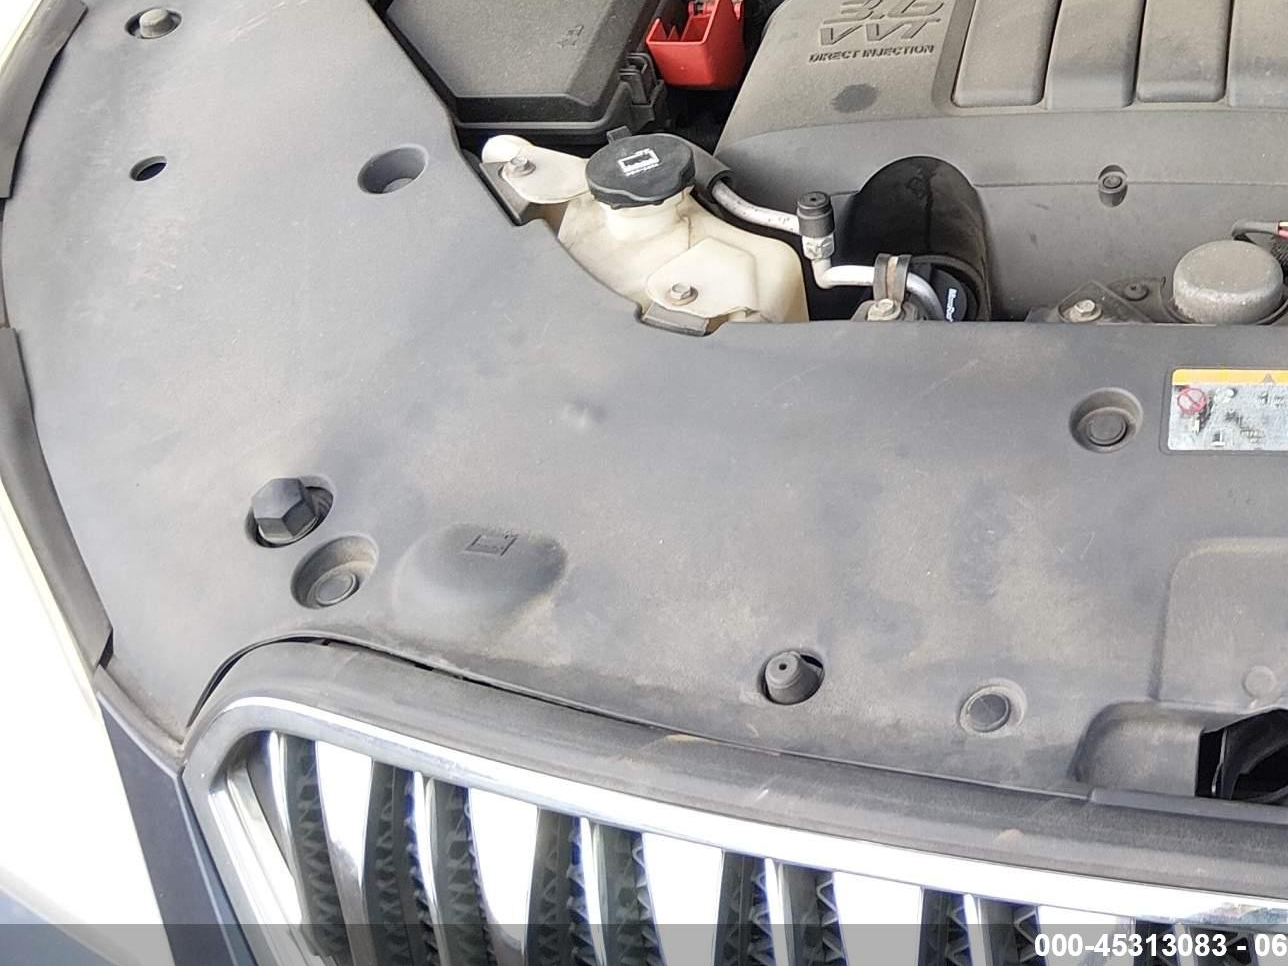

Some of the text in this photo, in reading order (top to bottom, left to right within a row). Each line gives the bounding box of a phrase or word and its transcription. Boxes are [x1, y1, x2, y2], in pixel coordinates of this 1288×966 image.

[820, 18, 941, 45] VVT
[808, 44, 935, 63] DIRECT INJECTION
